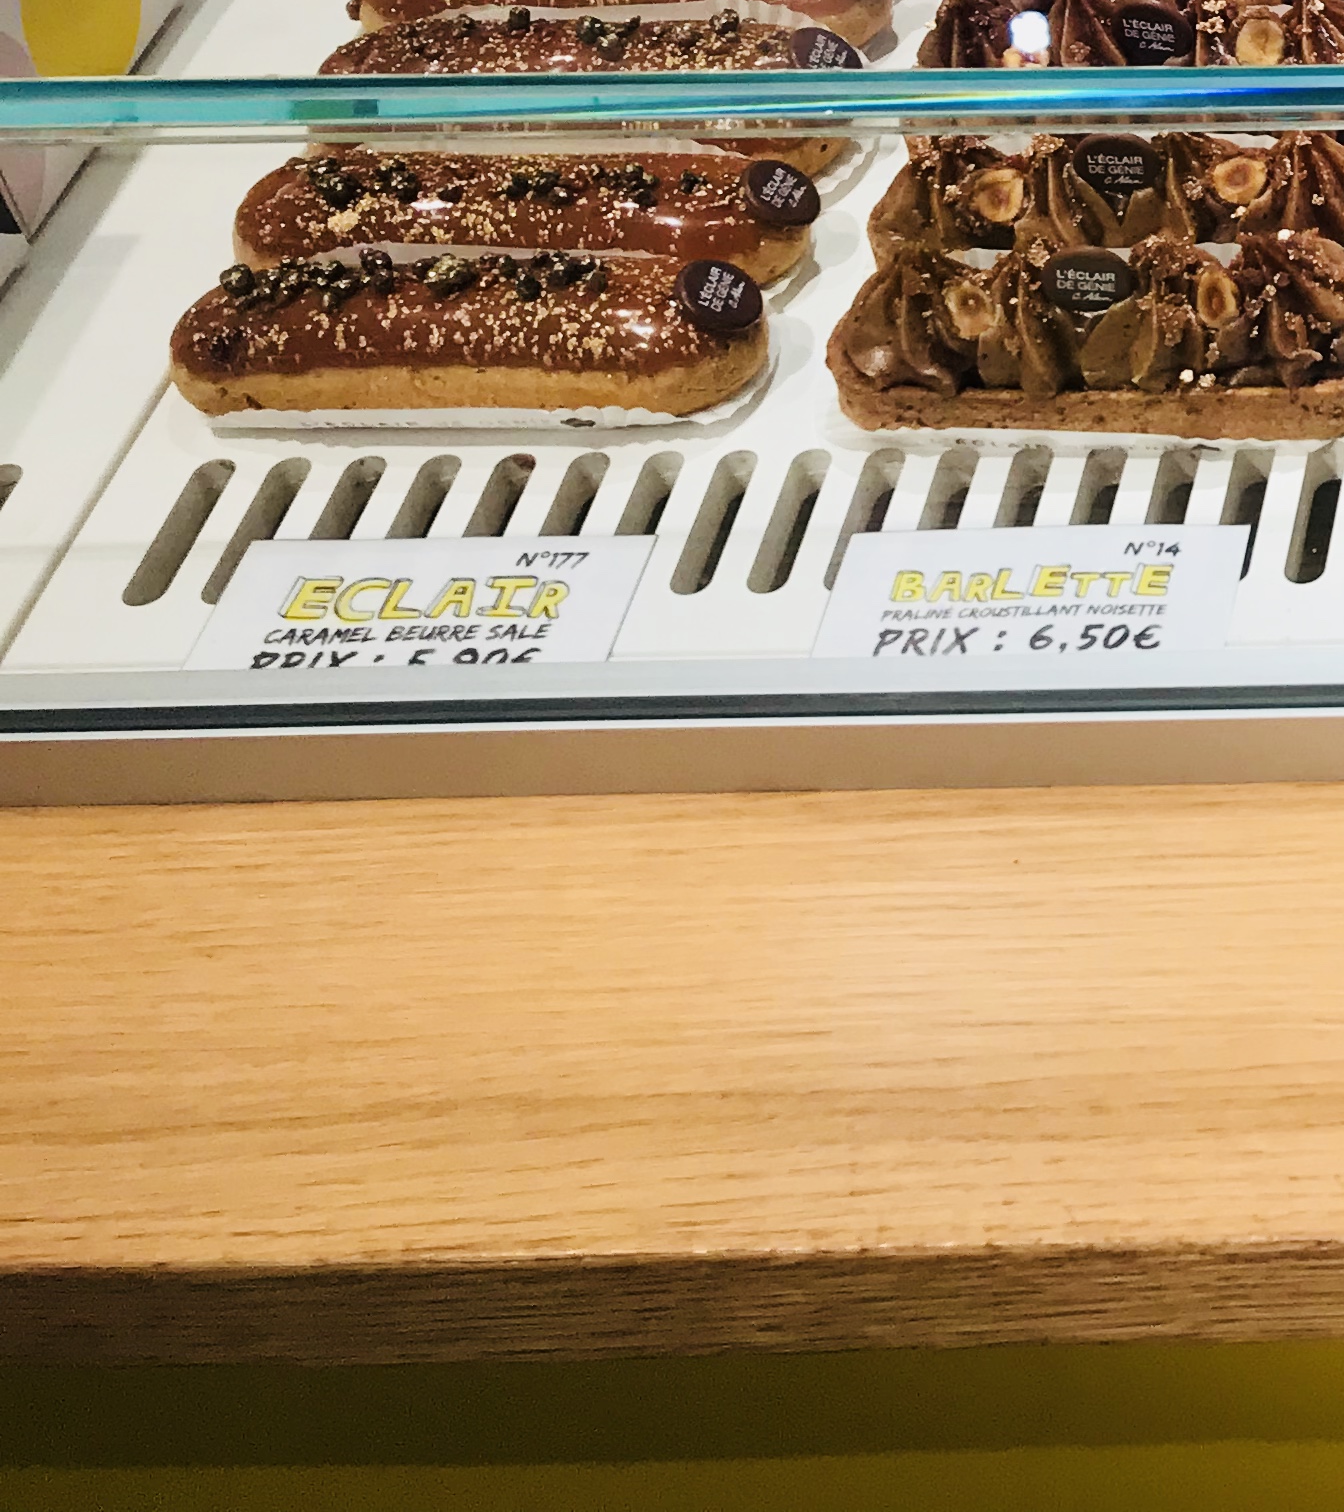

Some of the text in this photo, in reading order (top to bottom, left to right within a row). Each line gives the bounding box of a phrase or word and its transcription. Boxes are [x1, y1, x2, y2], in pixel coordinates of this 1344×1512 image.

[1122, 18, 1174, 32] L'ÉCLAIR
[1124, 28, 1140, 39] DE
[1086, 153, 1143, 165] L'ÉCLAIR
[1088, 165, 1105, 174] DE
[1056, 268, 1116, 282] L'ÉCLAIR
[1056, 279, 1075, 290] DE
[1124, 541, 1182, 557] N°14
[516, 550, 590, 569] N°177
[889, 563, 1175, 604] BARLETTE
[277, 575, 571, 621] ECLAIR
[958, 604, 1081, 619] CROUSTILLANT
[1085, 603, 1168, 617] NOISETTE
[263, 627, 376, 646] CARAMEL
[384, 624, 482, 643] BEURRE
[872, 626, 981, 657] PRIX
[1028, 623, 1163, 655] 6,50€
